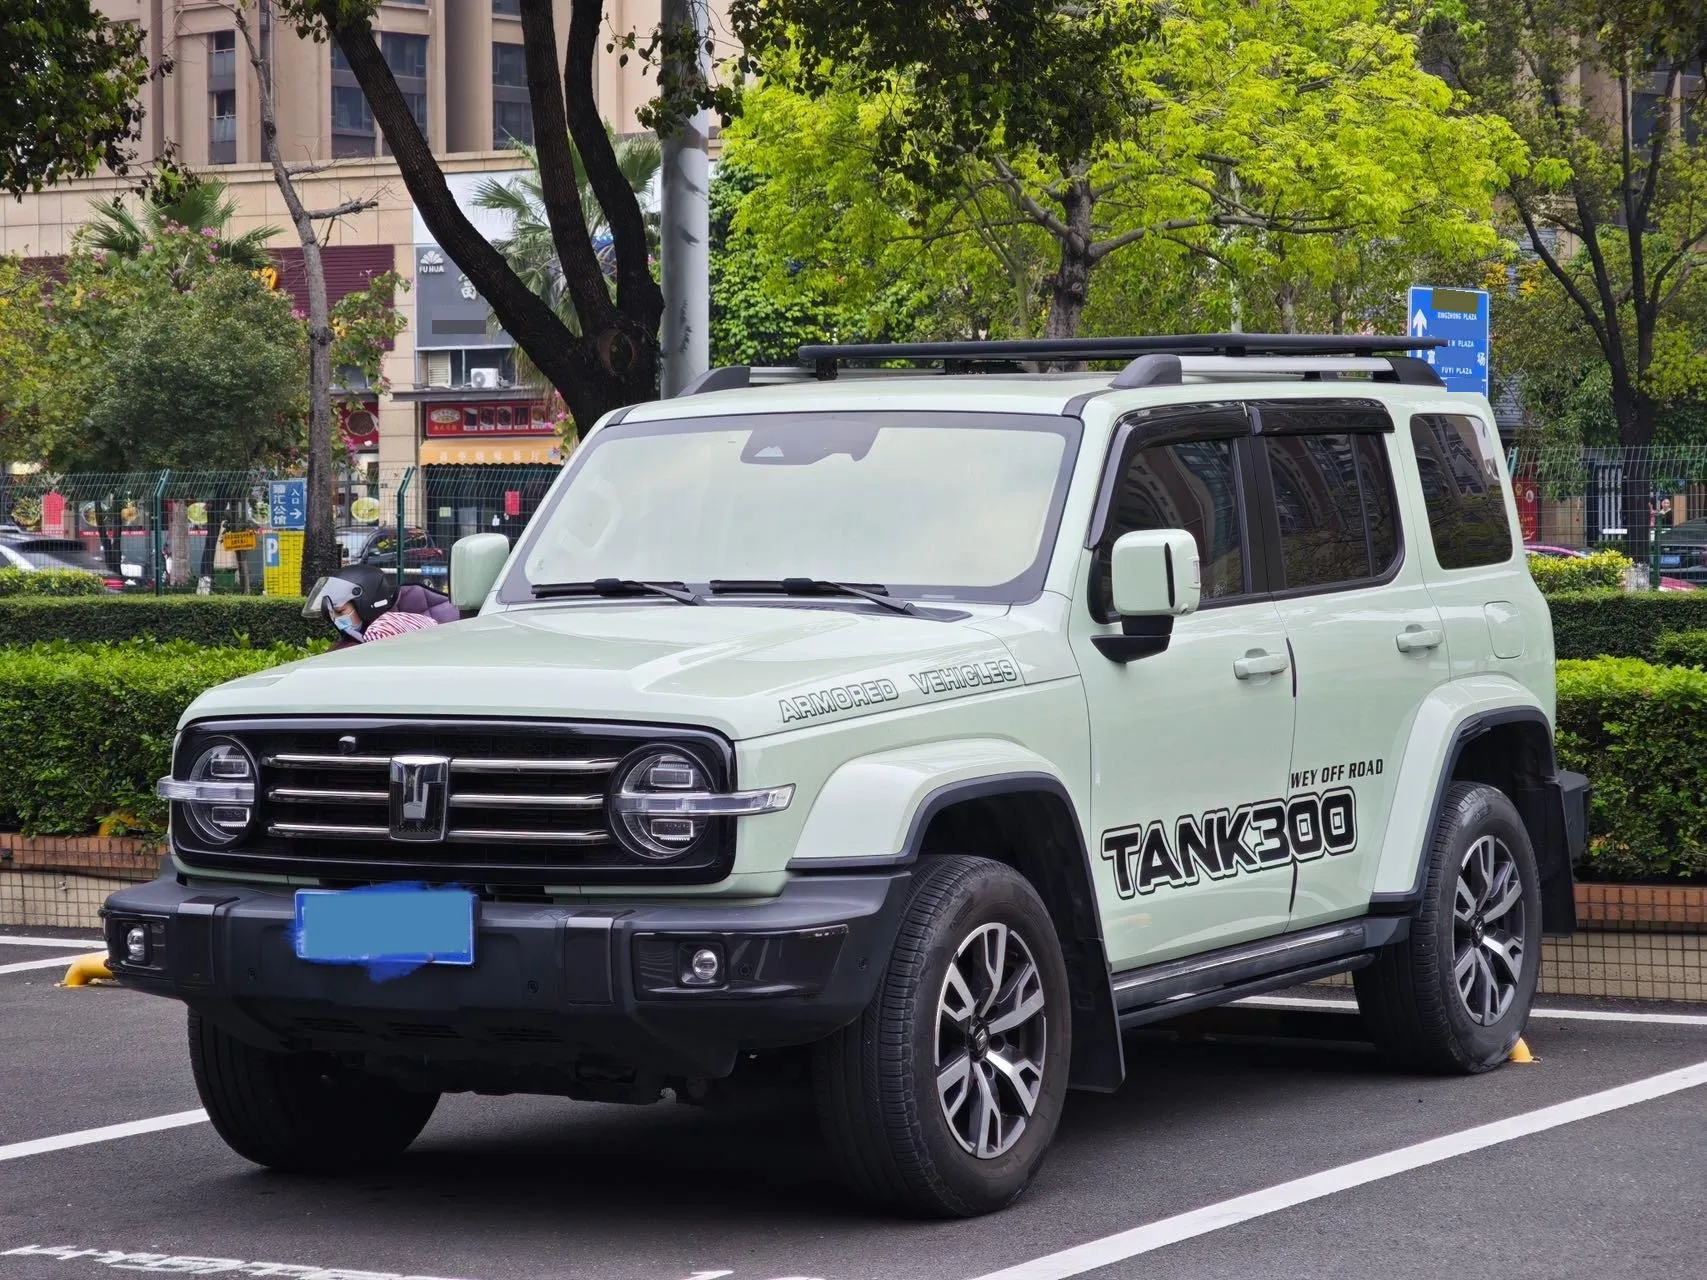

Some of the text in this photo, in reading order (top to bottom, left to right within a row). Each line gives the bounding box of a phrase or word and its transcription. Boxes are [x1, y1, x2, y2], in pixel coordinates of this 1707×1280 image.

[428, 265, 444, 273] HUA
[1463, 313, 1477, 321] PLAZA
[1458, 339, 1474, 347] PLAZA
[1456, 367, 1472, 375] PLAZA
[291, 488, 300, 504] 入口
[266, 537, 278, 563] P
[778, 659, 1018, 723] ARMORED VEHICLES
[1291, 758, 1384, 789] WEY OFF ROAD
[1101, 785, 1357, 901] TANK300
